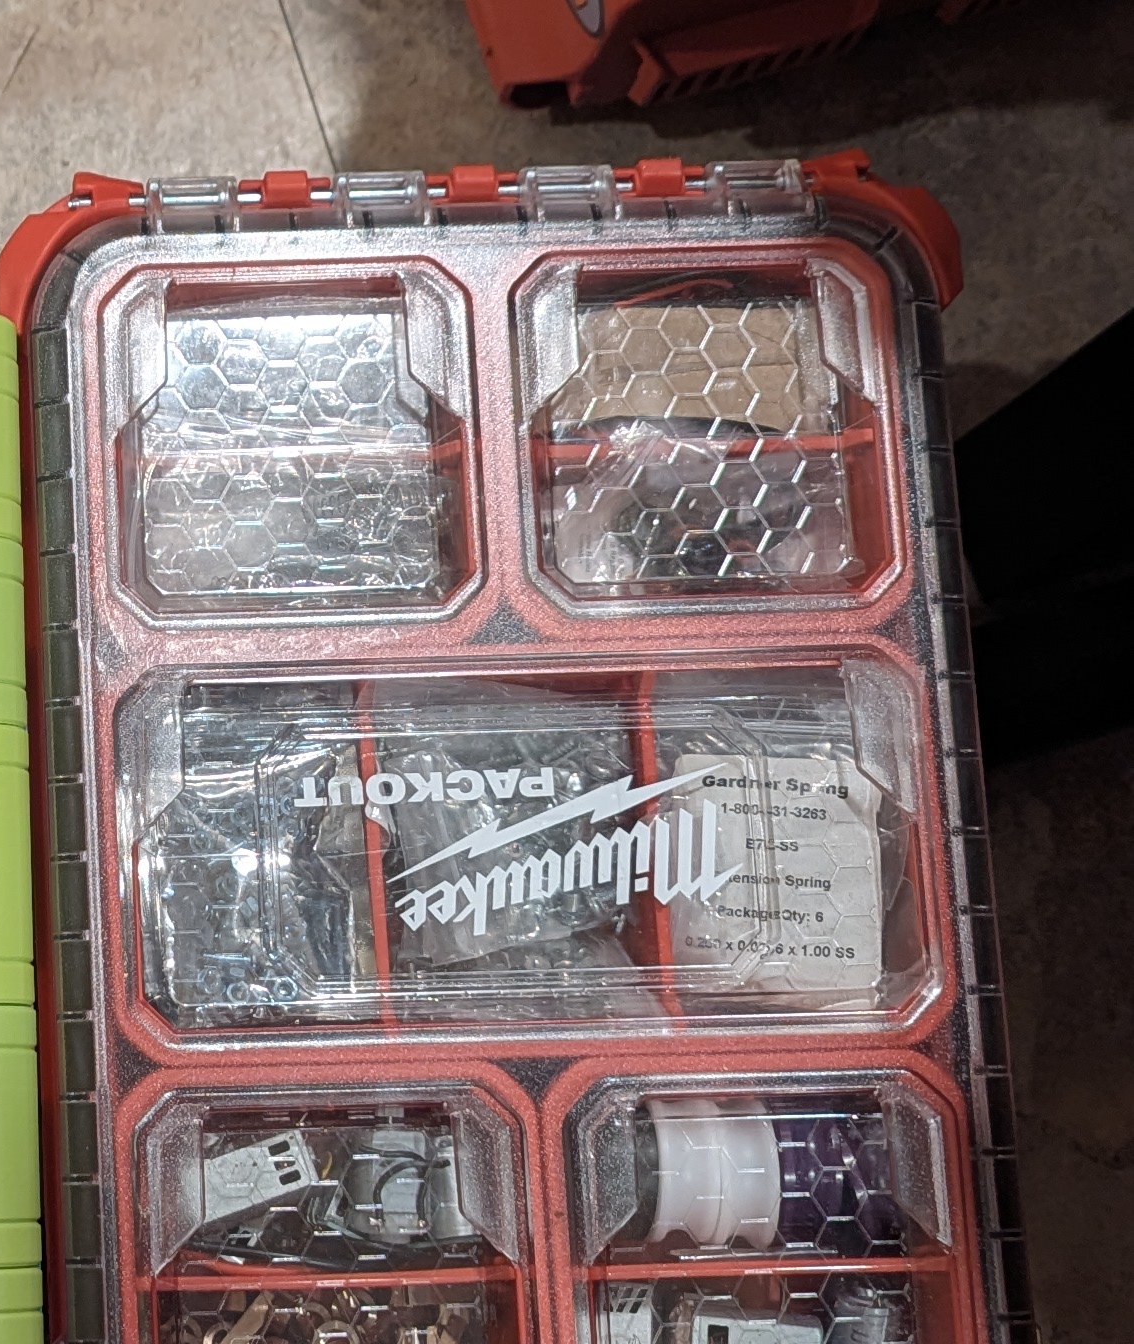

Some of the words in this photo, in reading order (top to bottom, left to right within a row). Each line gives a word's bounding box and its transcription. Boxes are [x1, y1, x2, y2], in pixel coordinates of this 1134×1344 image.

[293, 766, 556, 808] PACKOUT
[786, 777, 850, 800] Spng
[720, 802, 828, 821] 1-800-31-3263
[394, 797, 744, 937] Milwaukee
[727, 873, 781, 886] tension
[784, 874, 832, 892] Spring
[781, 908, 811, 925] Qty:
[814, 911, 825, 923] 6
[725, 941, 734, 951] x
[787, 945, 797, 956] x
[801, 944, 832, 958] 1.00
[834, 946, 856, 960] SS
